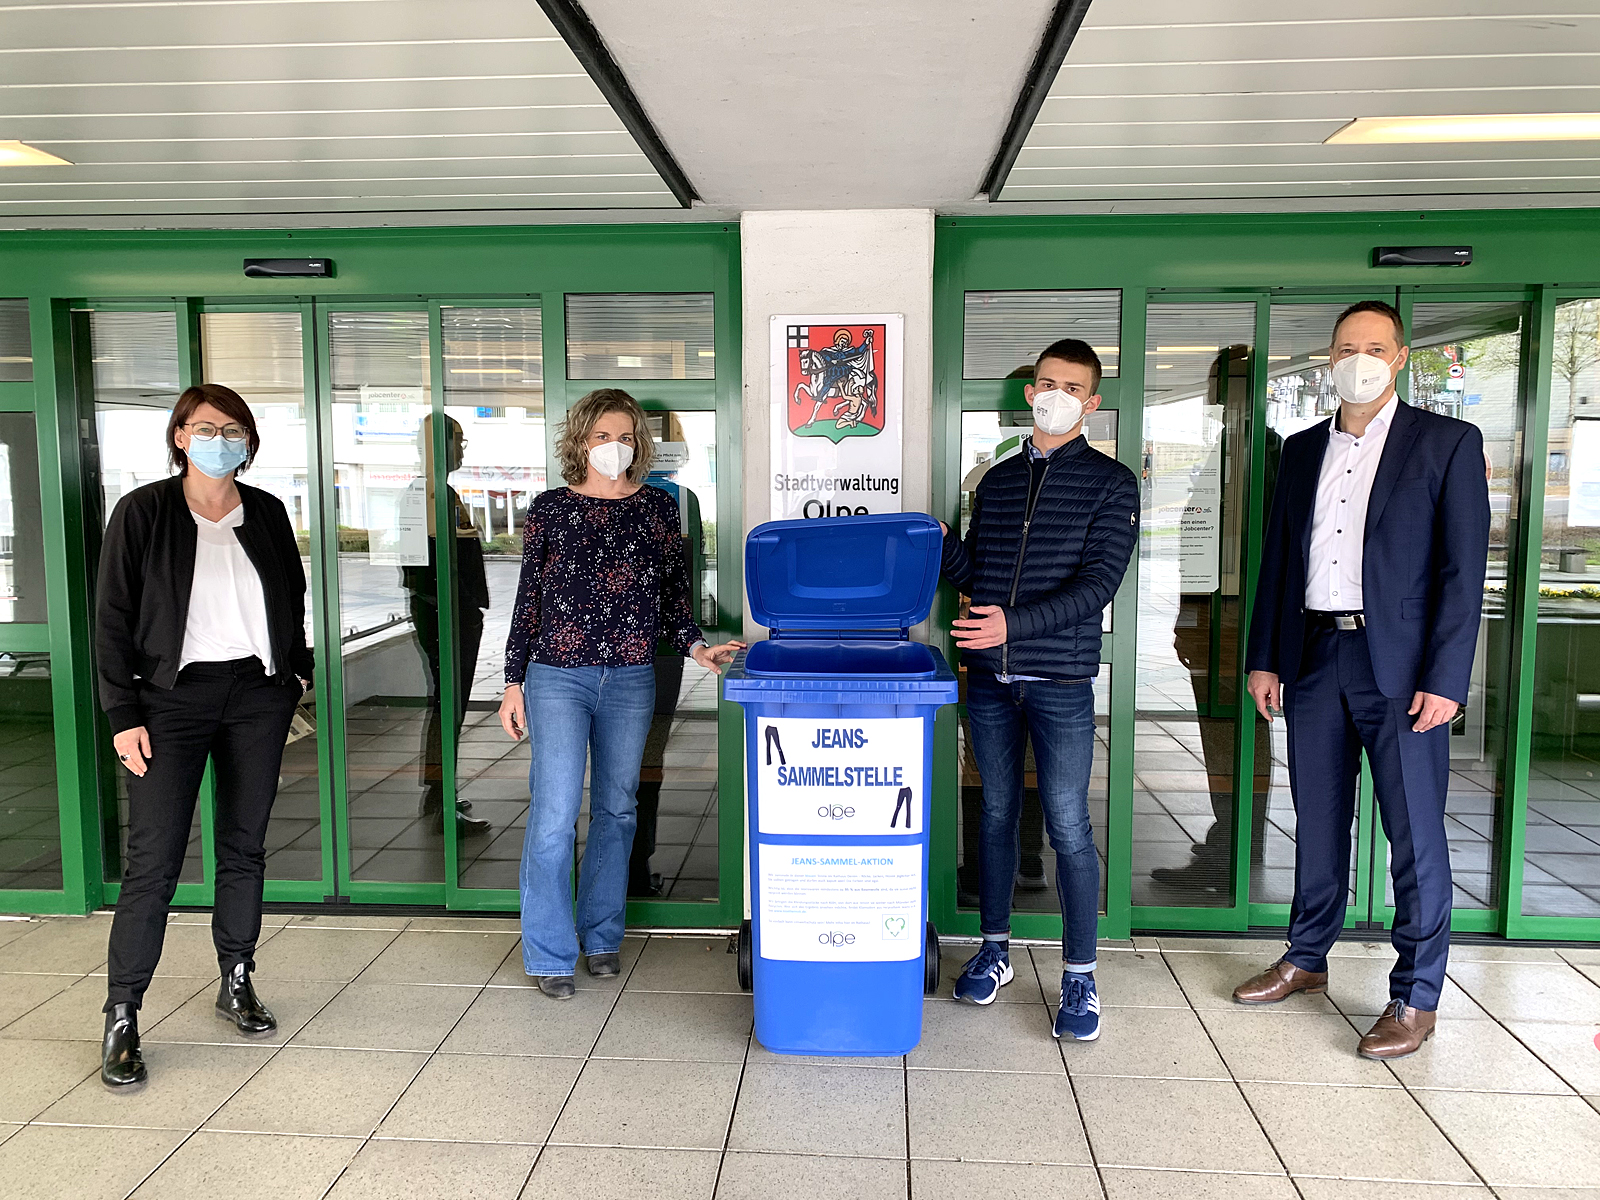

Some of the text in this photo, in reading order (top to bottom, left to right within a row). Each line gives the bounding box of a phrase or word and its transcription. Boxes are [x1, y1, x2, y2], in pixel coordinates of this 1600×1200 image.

[368, 392, 401, 400] jobcenter
[774, 473, 899, 494] Stadtverwaltung
[1158, 505, 1196, 514] jobcenter
[811, 727, 869, 749] JEANS-
[777, 765, 903, 787] SAMMELSTELLE
[817, 803, 856, 820] olpe
[790, 857, 894, 867] JEANS-SAMMEL-AKTION
[818, 931, 856, 948] olpe
